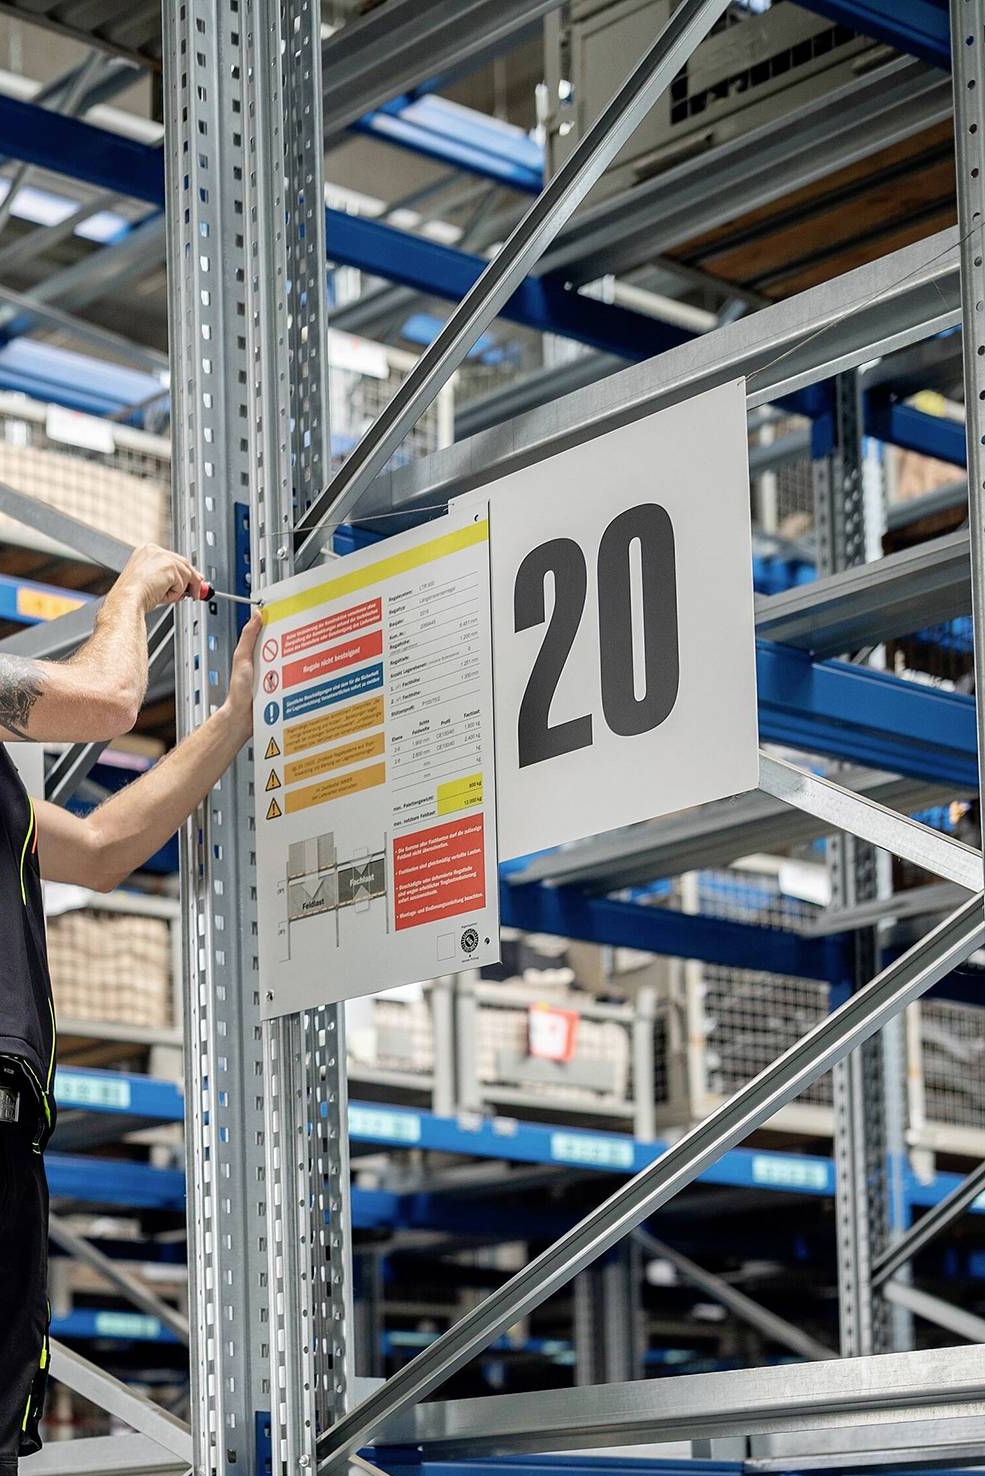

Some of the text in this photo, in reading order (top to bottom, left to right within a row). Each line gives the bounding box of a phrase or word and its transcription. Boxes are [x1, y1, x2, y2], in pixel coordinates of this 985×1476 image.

[514, 503, 679, 769] 20
[303, 661, 320, 674] Regale
[321, 656, 333, 667] nicht
[350, 874, 374, 887] Fachlast
[303, 898, 325, 910] Feldlast
